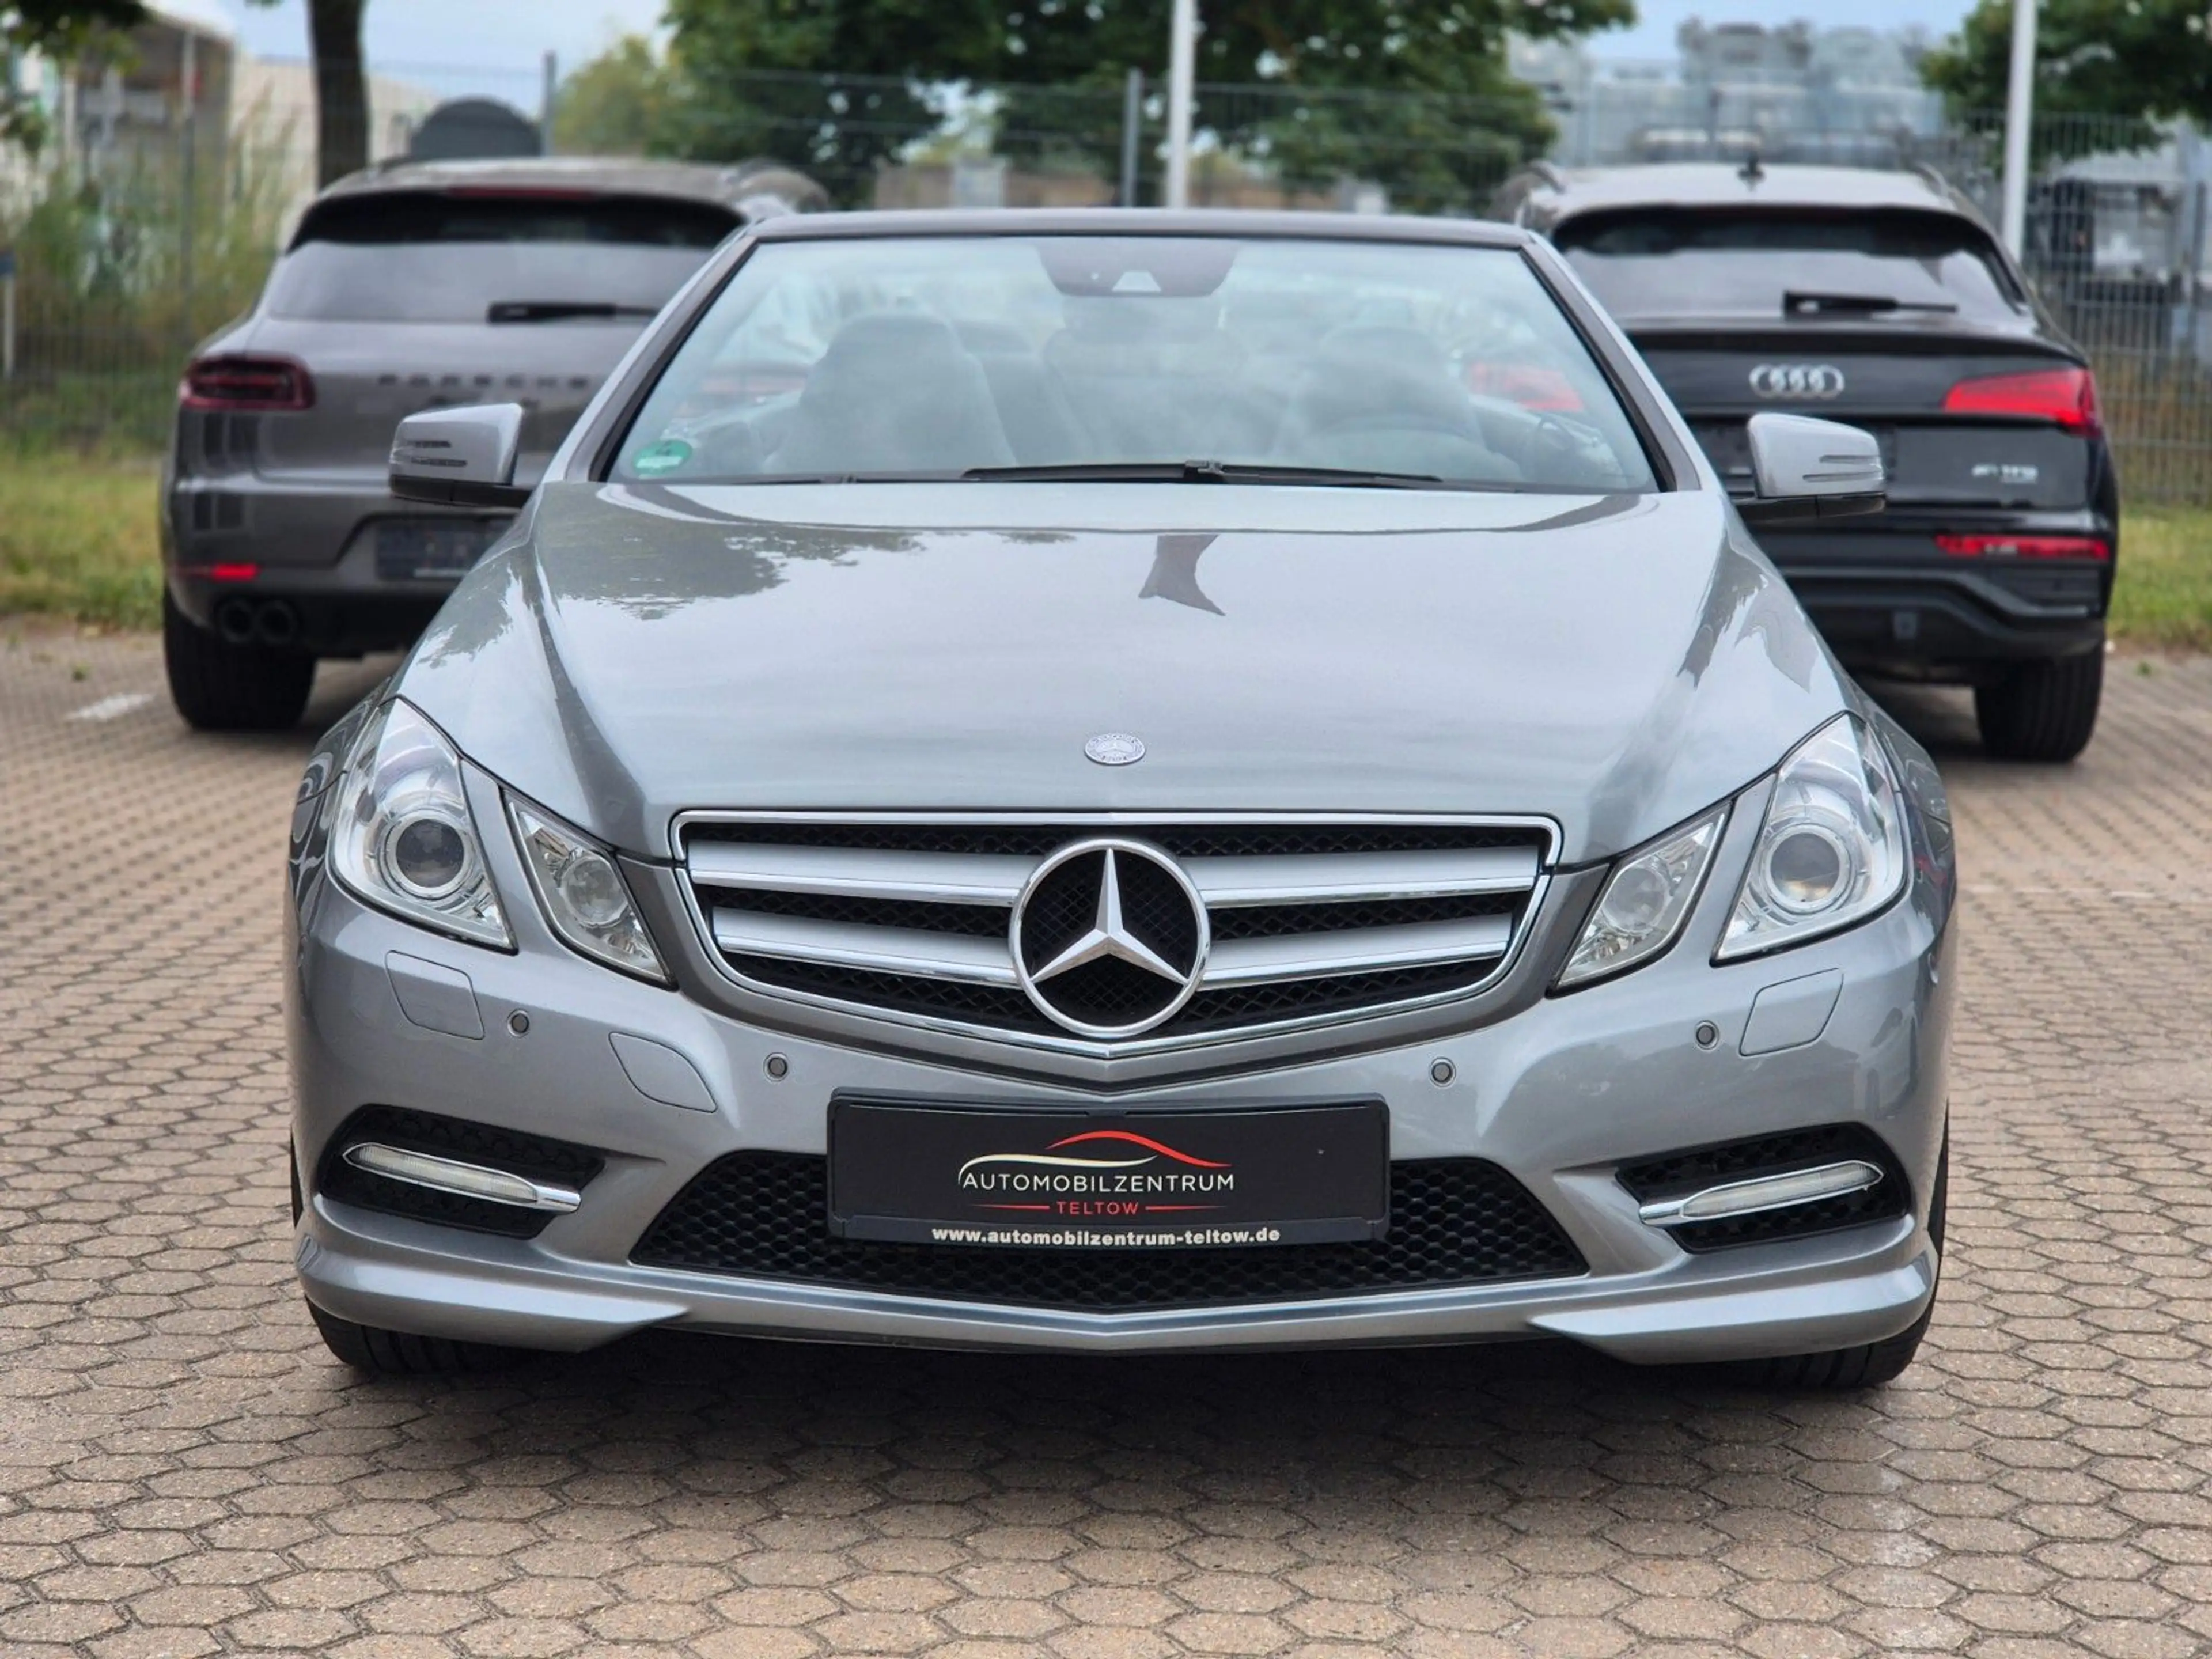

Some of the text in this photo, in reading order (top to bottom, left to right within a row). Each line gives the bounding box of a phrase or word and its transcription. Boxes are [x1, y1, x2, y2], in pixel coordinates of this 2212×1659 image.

[963, 1172, 1234, 1192] AUTOMOBILZENTRUM
[1056, 1201, 1139, 1215] TELTOW
[931, 1228, 1281, 1247] www.automobilzentrum-teltow.de
